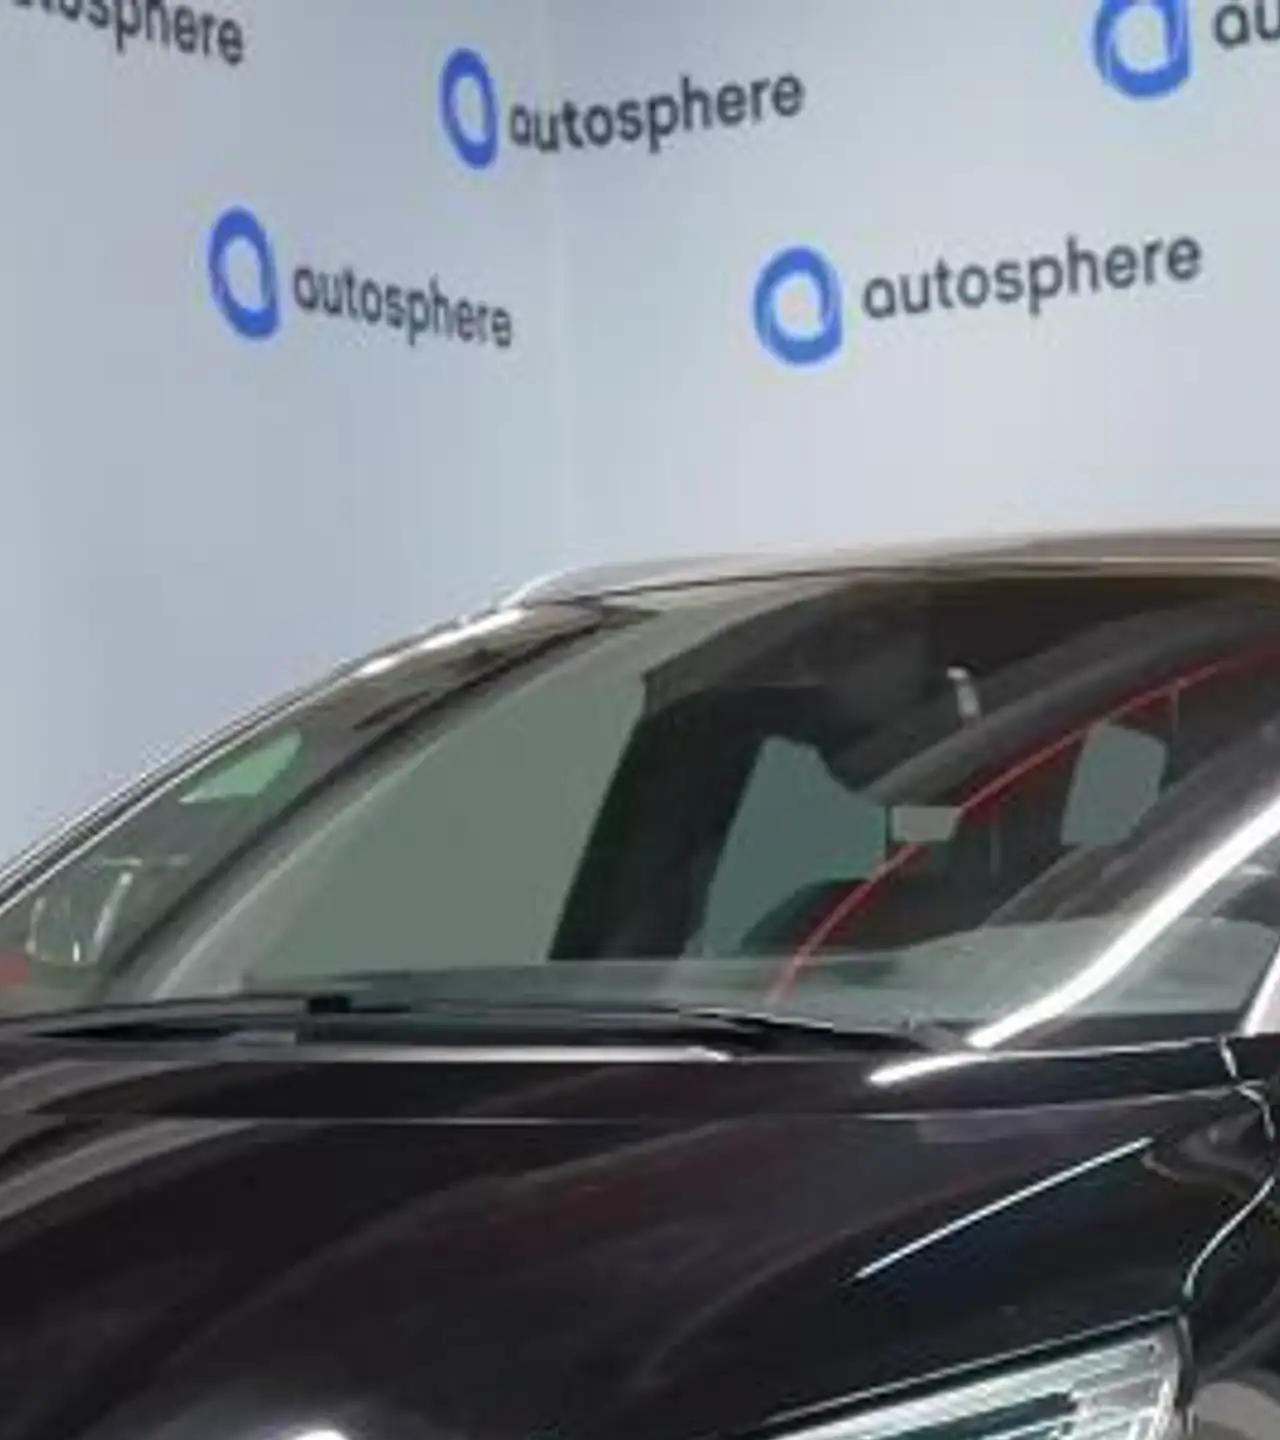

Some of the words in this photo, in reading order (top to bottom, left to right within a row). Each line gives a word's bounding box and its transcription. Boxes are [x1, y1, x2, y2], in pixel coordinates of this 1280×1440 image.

[508, 73, 805, 155] autosphere
[291, 265, 513, 349] autosphere
[860, 234, 1204, 321] autosphere
